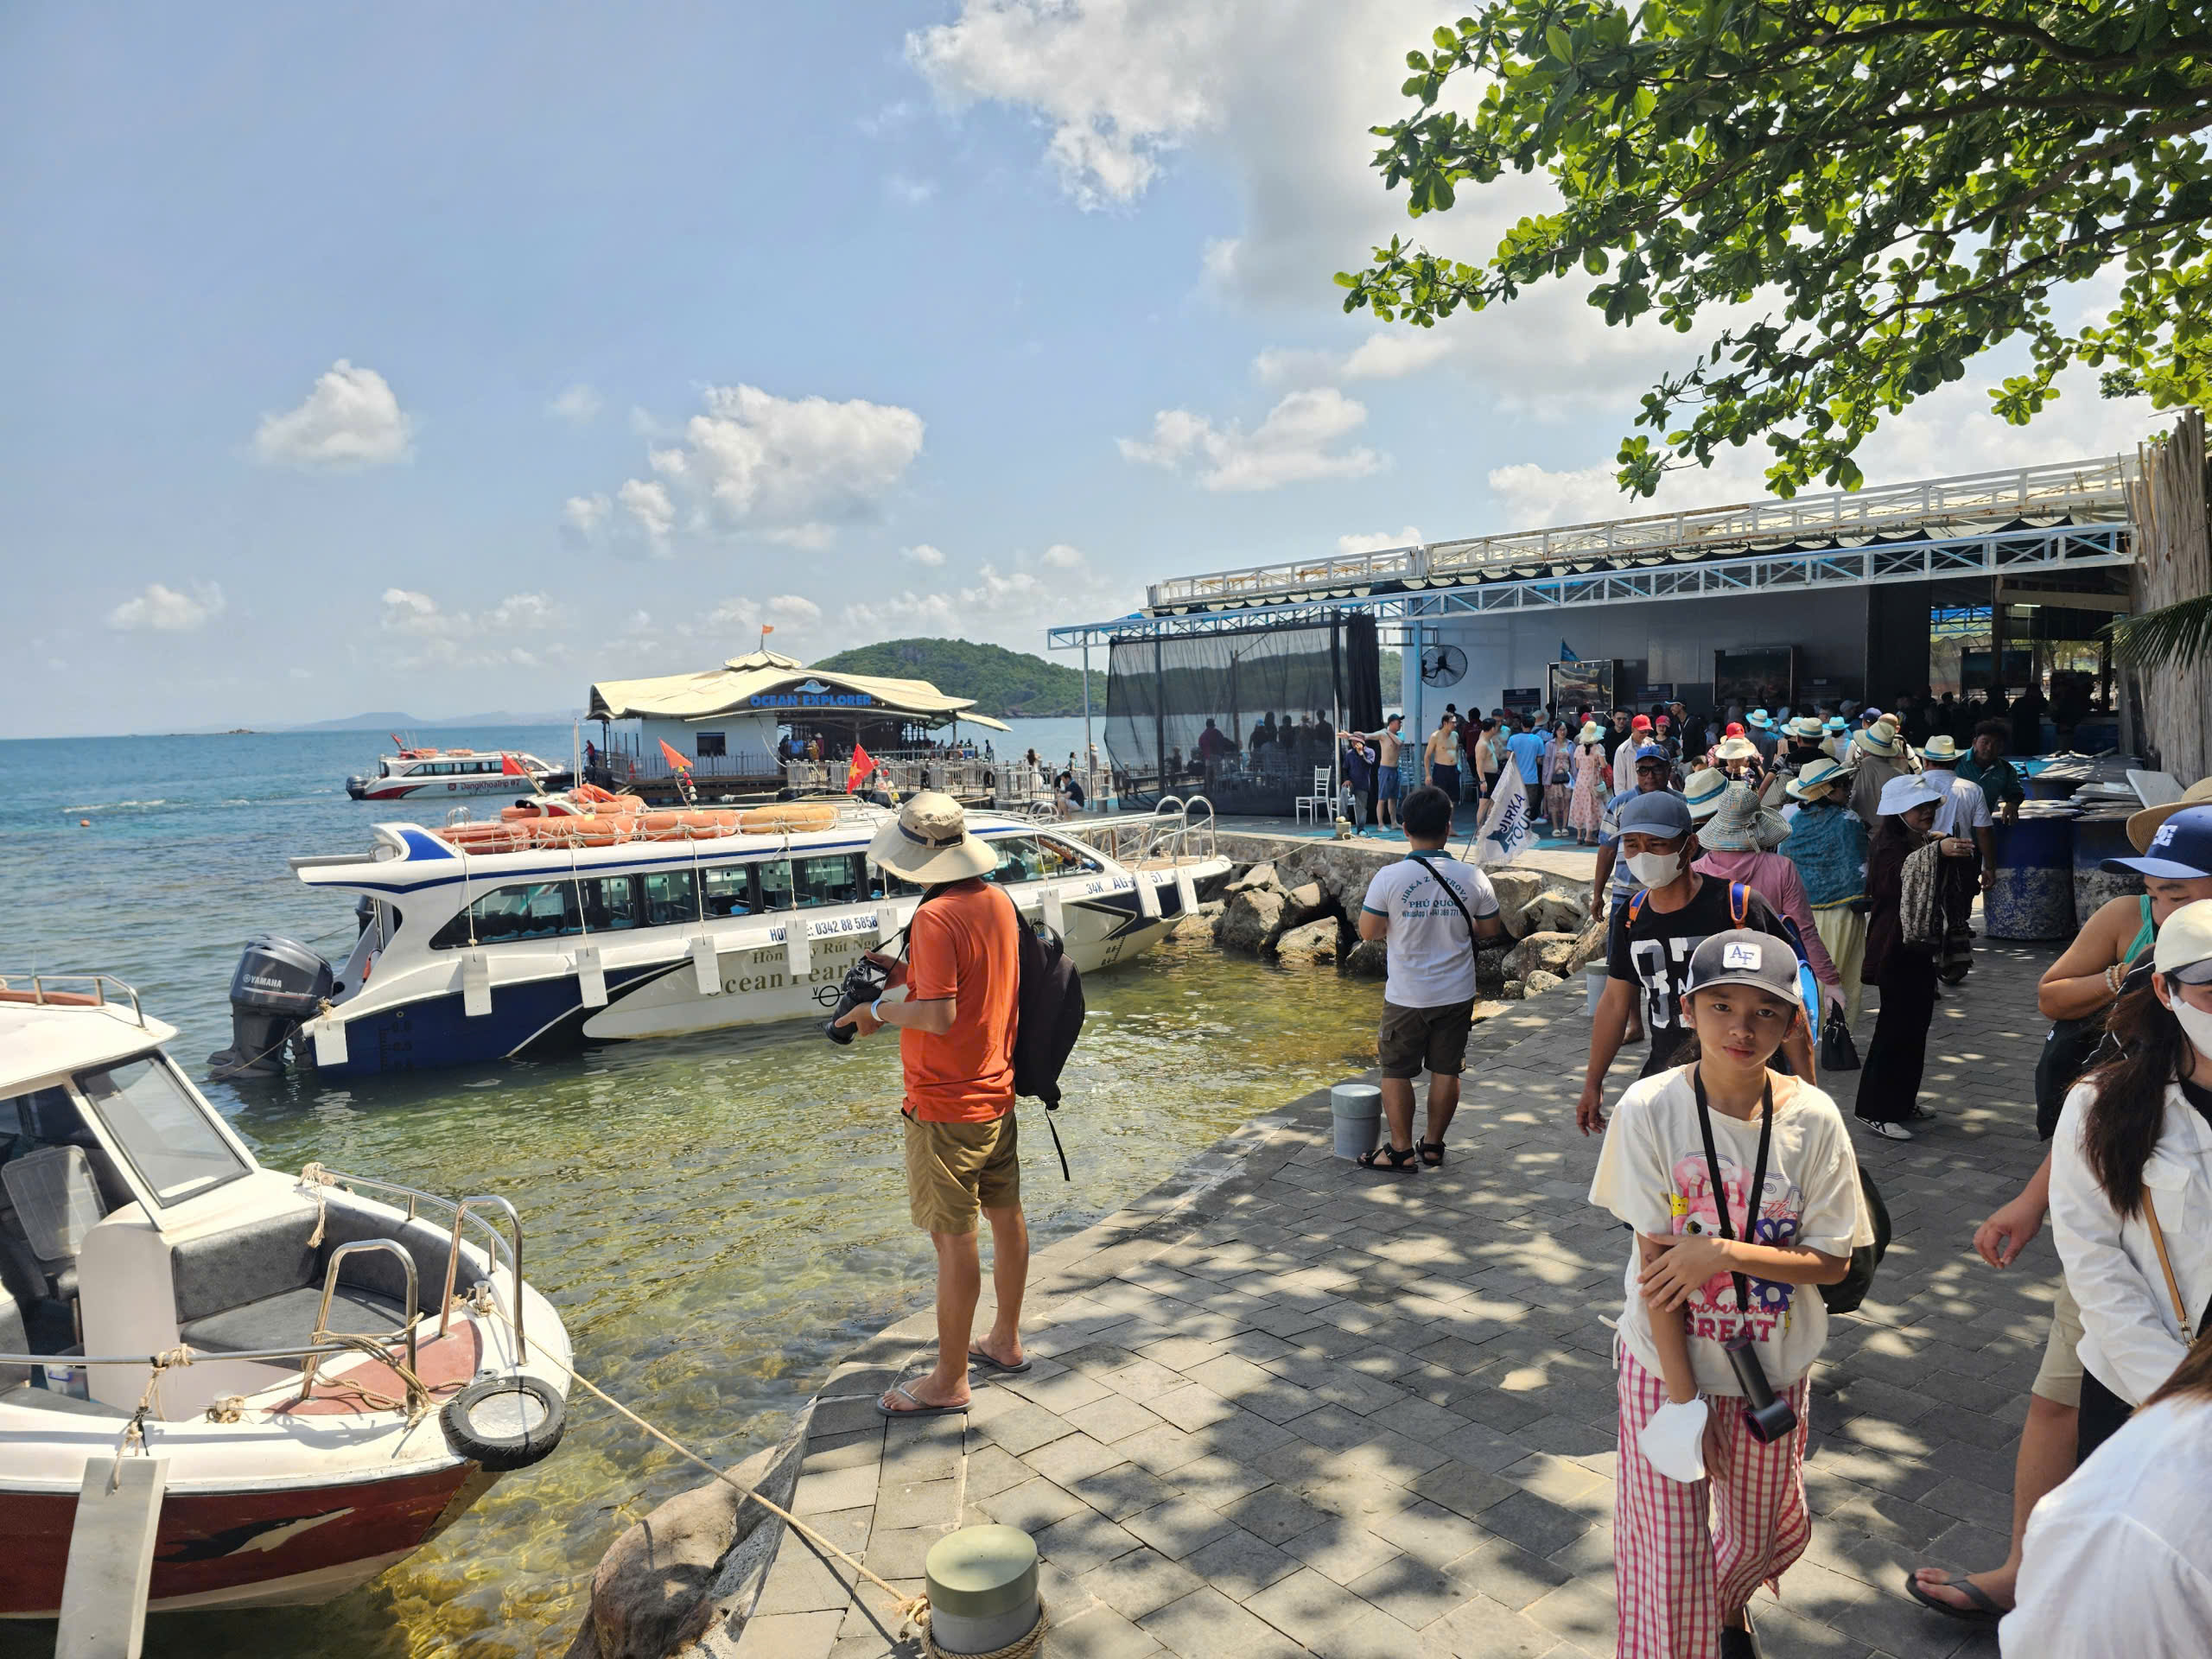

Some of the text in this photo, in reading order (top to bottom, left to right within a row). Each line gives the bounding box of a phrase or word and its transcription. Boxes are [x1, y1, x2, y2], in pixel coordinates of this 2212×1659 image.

[750, 694, 871, 707] OCEAN EXPLORER
[1499, 793, 1525, 832] JIRKA
[1086, 881, 1104, 894] 34K
[1402, 880, 1422, 904] JIRKA
[1409, 899, 1430, 908] PHÚ
[815, 922, 839, 936] 0342
[841, 921, 853, 931] 88
[855, 915, 877, 930] 5858
[753, 951, 783, 964] Hòn
[823, 940, 848, 954] Rút
[1729, 945, 1755, 965] AF
[251, 975, 283, 988] YAMAHA
[708, 973, 783, 997] cean
